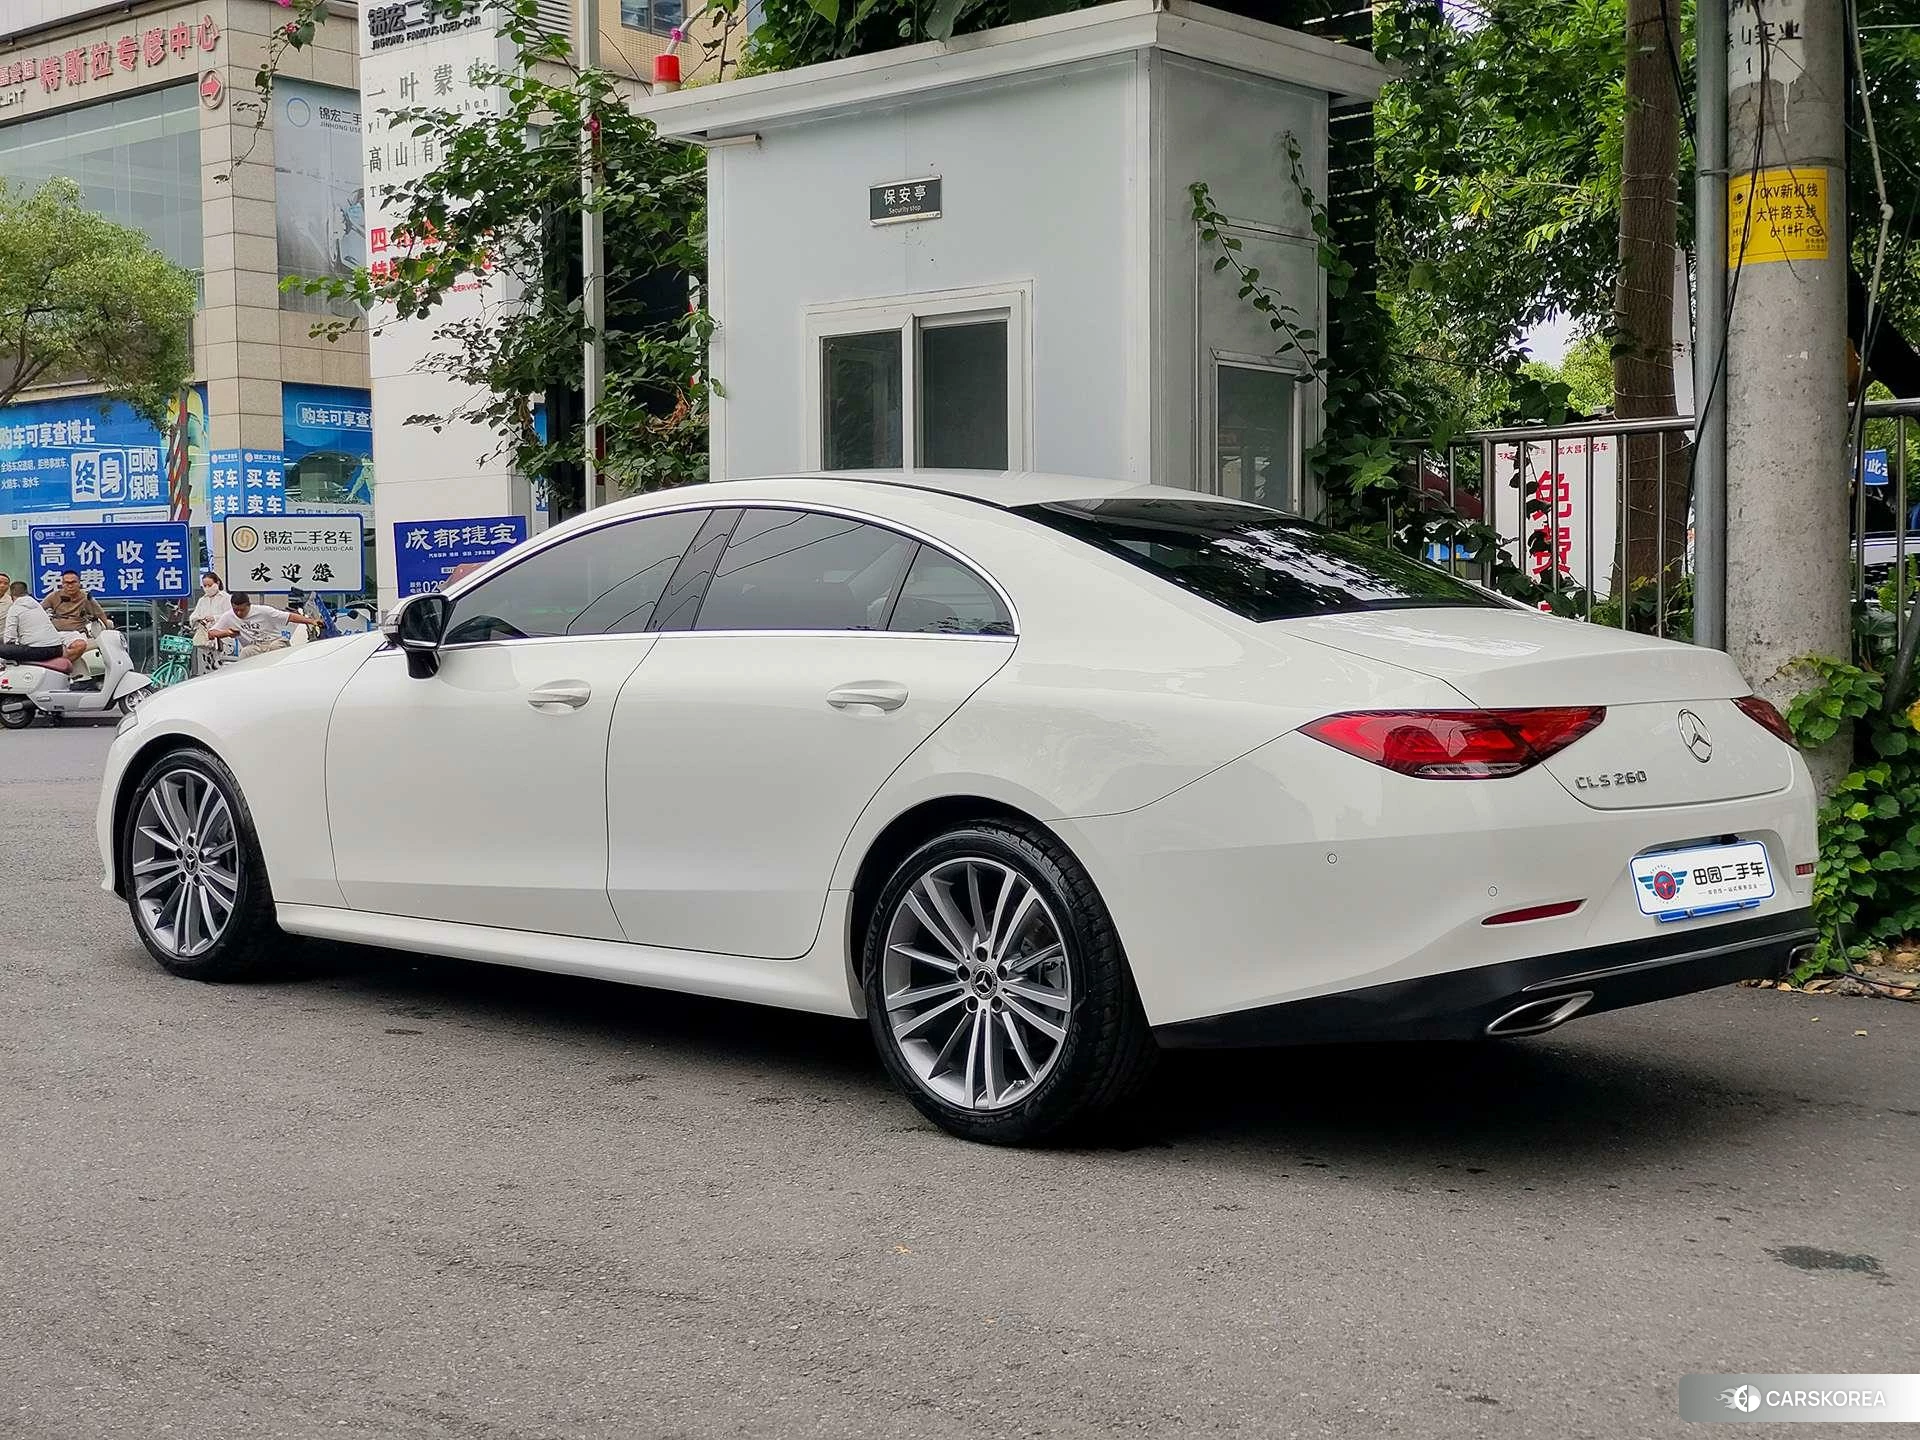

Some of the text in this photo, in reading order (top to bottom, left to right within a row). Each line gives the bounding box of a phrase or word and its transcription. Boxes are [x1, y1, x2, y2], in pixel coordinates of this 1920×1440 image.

[39, 15, 220, 94] 特斯拉专修中心
[884, 184, 926, 206] 保安亭
[301, 407, 371, 428] 购车可享查
[212, 468, 239, 489] 买车
[246, 468, 282, 489] 买车
[213, 494, 240, 514] 卖车
[247, 494, 283, 514] 卖车
[262, 530, 353, 545] 锦宏二手名车
[405, 523, 517, 550] 成都捷宝
[39, 538, 183, 568] 高价收车
[39, 566, 183, 594] 免费评估
[250, 562, 335, 583] 欢迎您
[1574, 770, 1648, 790] CLS 260
[1692, 861, 1765, 886] 田园二手车
